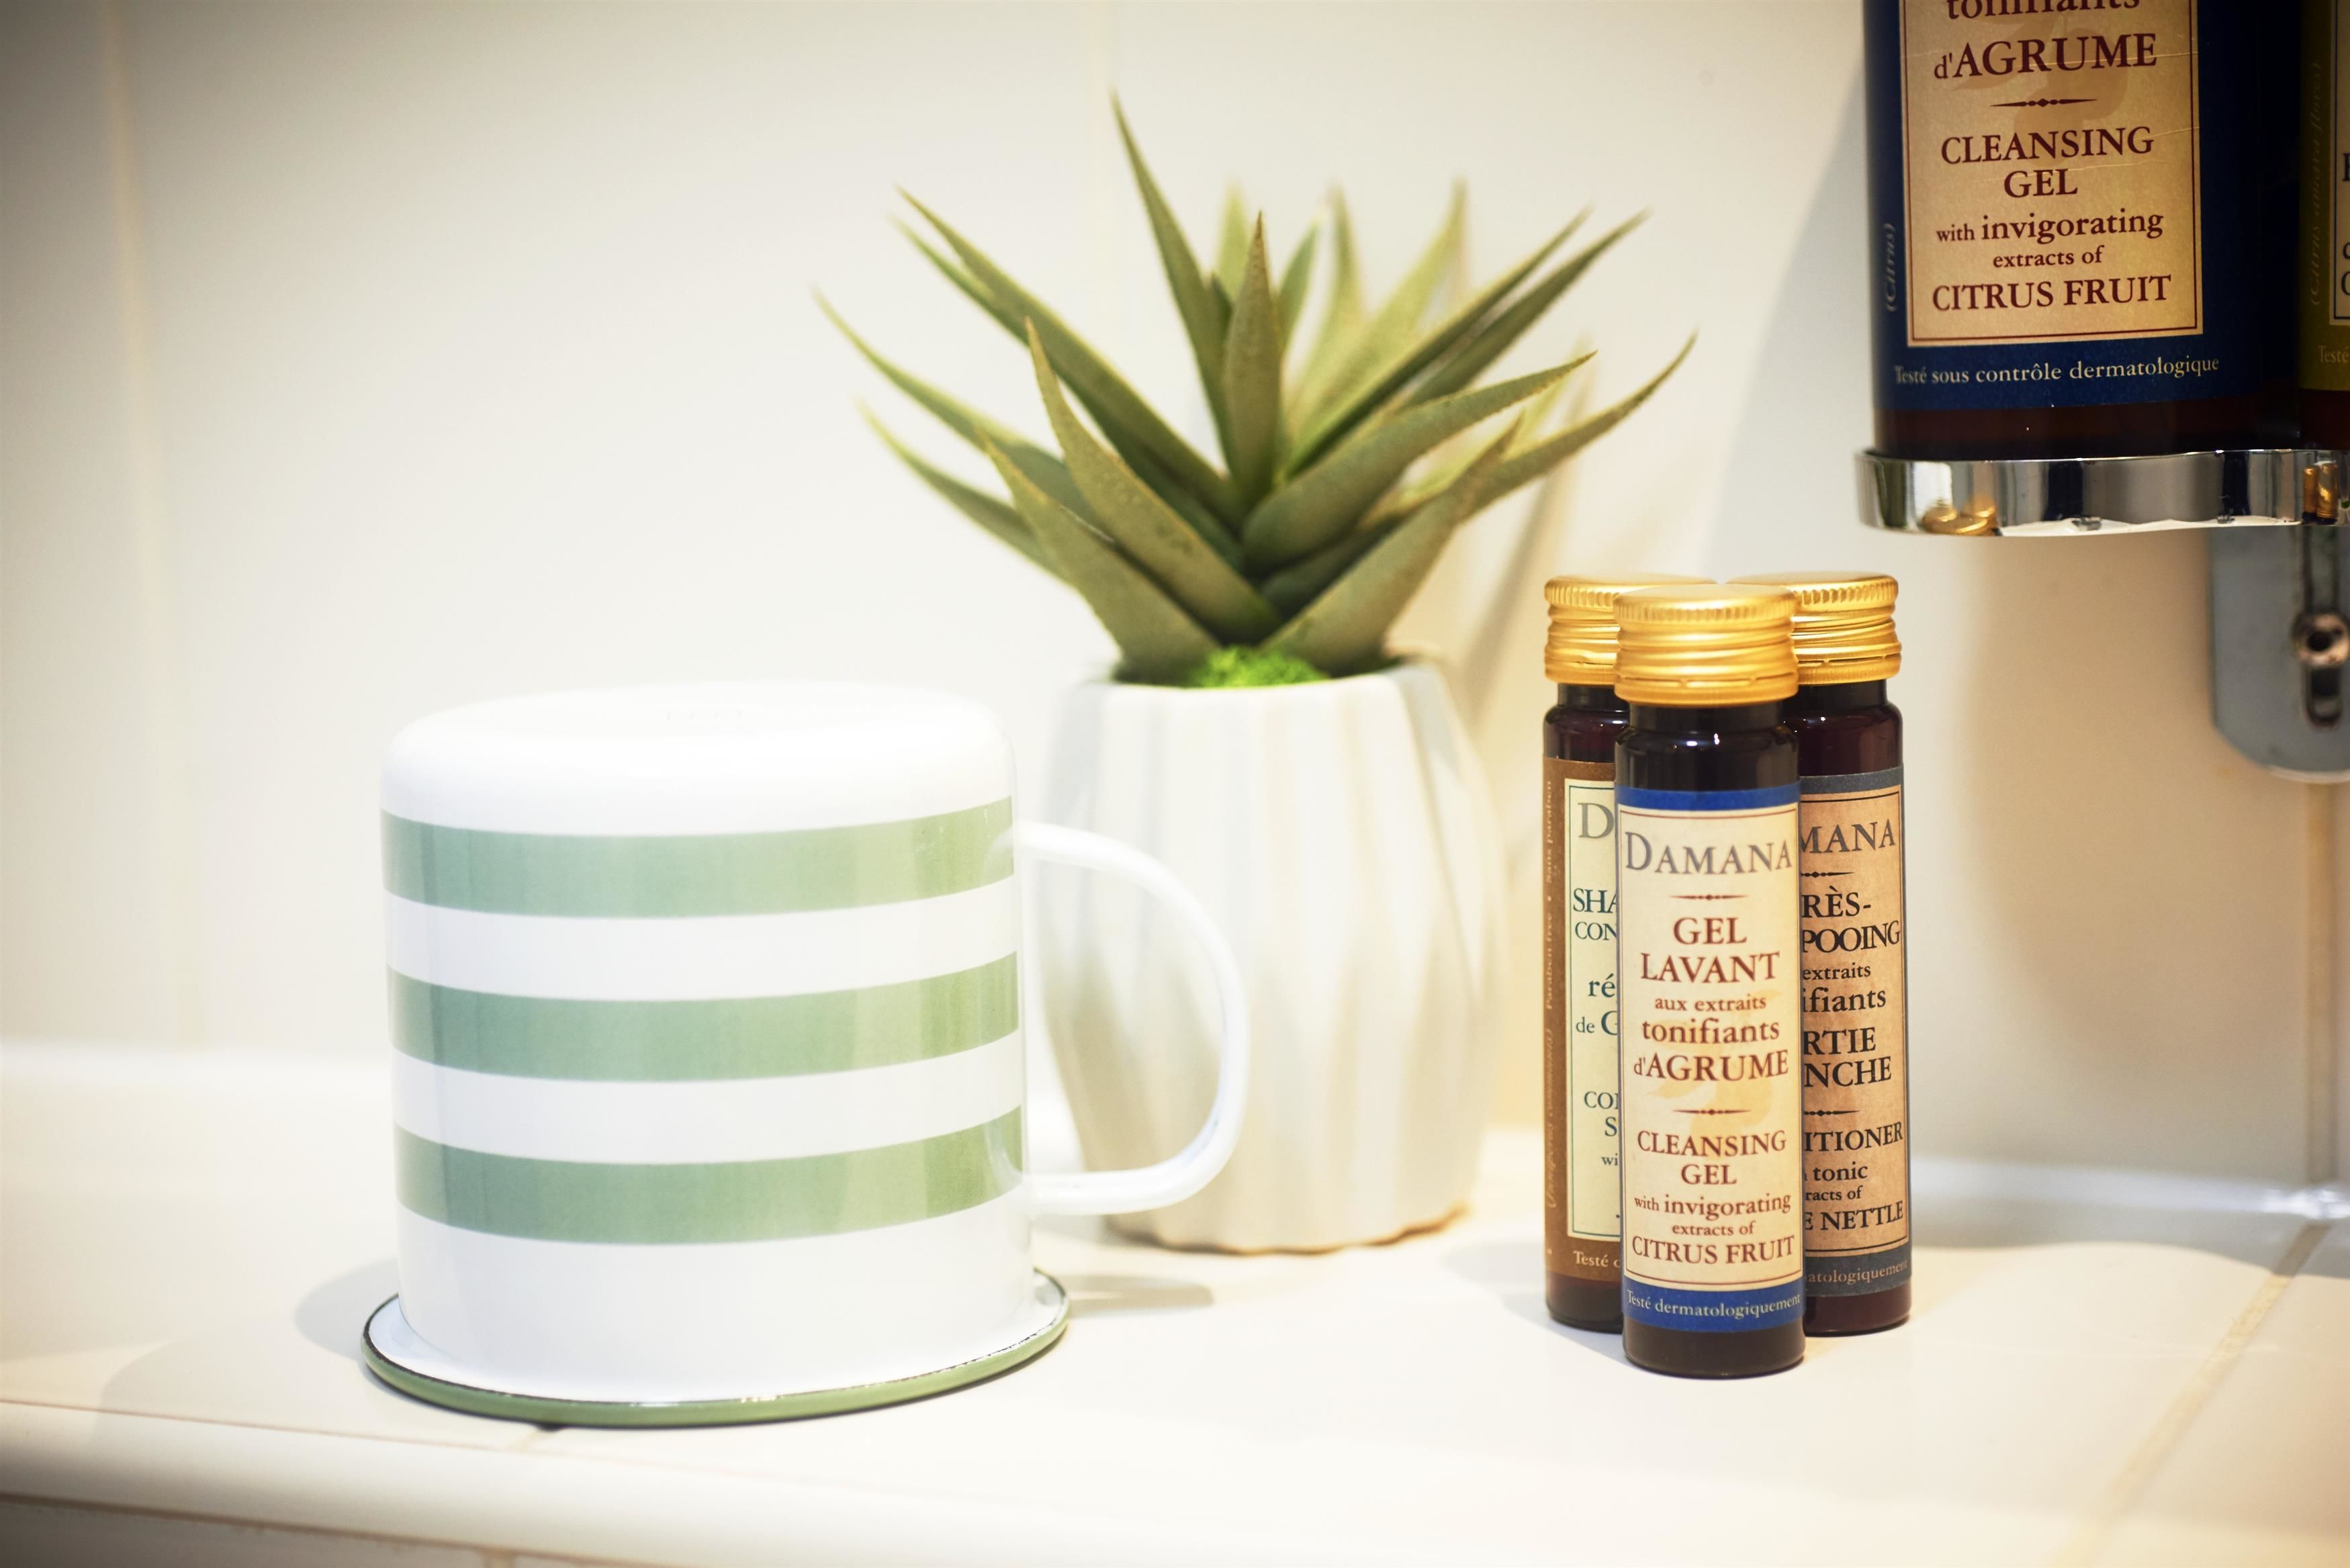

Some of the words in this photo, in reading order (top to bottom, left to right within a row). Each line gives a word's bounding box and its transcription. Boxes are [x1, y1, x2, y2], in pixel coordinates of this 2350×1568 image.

[1934, 32, 2158, 80] d'AGRUME
[1940, 126, 2155, 165] CLEANSING
[2003, 168, 2079, 199] GEL
[1936, 224, 1975, 244] with
[1981, 207, 2165, 244] invigorating
[1993, 249, 2075, 269] extracts
[2081, 245, 2106, 265] of
[1932, 281, 2055, 312] CITRUS
[2063, 275, 2172, 308] FRUIT
[1895, 365, 1928, 385] Testé
[1932, 368, 1970, 385] sous
[1975, 361, 2063, 383] contrôle
[2069, 355, 2220, 380] dermatologique
[1799, 818, 1896, 854] MANA
[1625, 831, 1793, 874] DAMANA
[1801, 885, 1872, 919] RÈS-
[1673, 917, 1748, 946] GEL
[1802, 920, 1901, 953] POOING
[1640, 951, 1781, 984] LAVANT
[1803, 962, 1872, 980] extraits
[1655, 997, 1688, 1012] aux
[1694, 993, 1767, 1013] extraits
[1576, 1016, 1595, 1033] de
[1642, 1017, 1781, 1044] tonifiants
[1803, 1027, 1877, 1056] RTIE
[1634, 1050, 1790, 1082] d'AGRUME
[1804, 1056, 1893, 1088] NCHE
[1637, 1129, 1787, 1158] CLEANSING
[1804, 1121, 1904, 1152] ITIONER
[1601, 1153, 1619, 1166] wi
[1680, 1163, 1738, 1186] GEL
[1813, 1161, 1868, 1182] tonic
[1634, 1195, 1660, 1212] with
[1664, 1193, 1793, 1222] invigorating
[1805, 1190, 1843, 1202] racts
[1847, 1185, 1864, 1201] of
[1672, 1222, 1734, 1237] extracts
[1739, 1220, 1756, 1236] of
[1820, 1200, 1904, 1231] NETTLE
[1572, 1250, 1609, 1269] Testé
[1631, 1235, 1719, 1266] CITRUS
[1725, 1234, 1795, 1265] FRUIT
[1805, 1259, 1908, 1286] atologiquement
[1626, 1288, 1652, 1311] Testé
[1654, 1291, 1802, 1321] dermatologiquement
